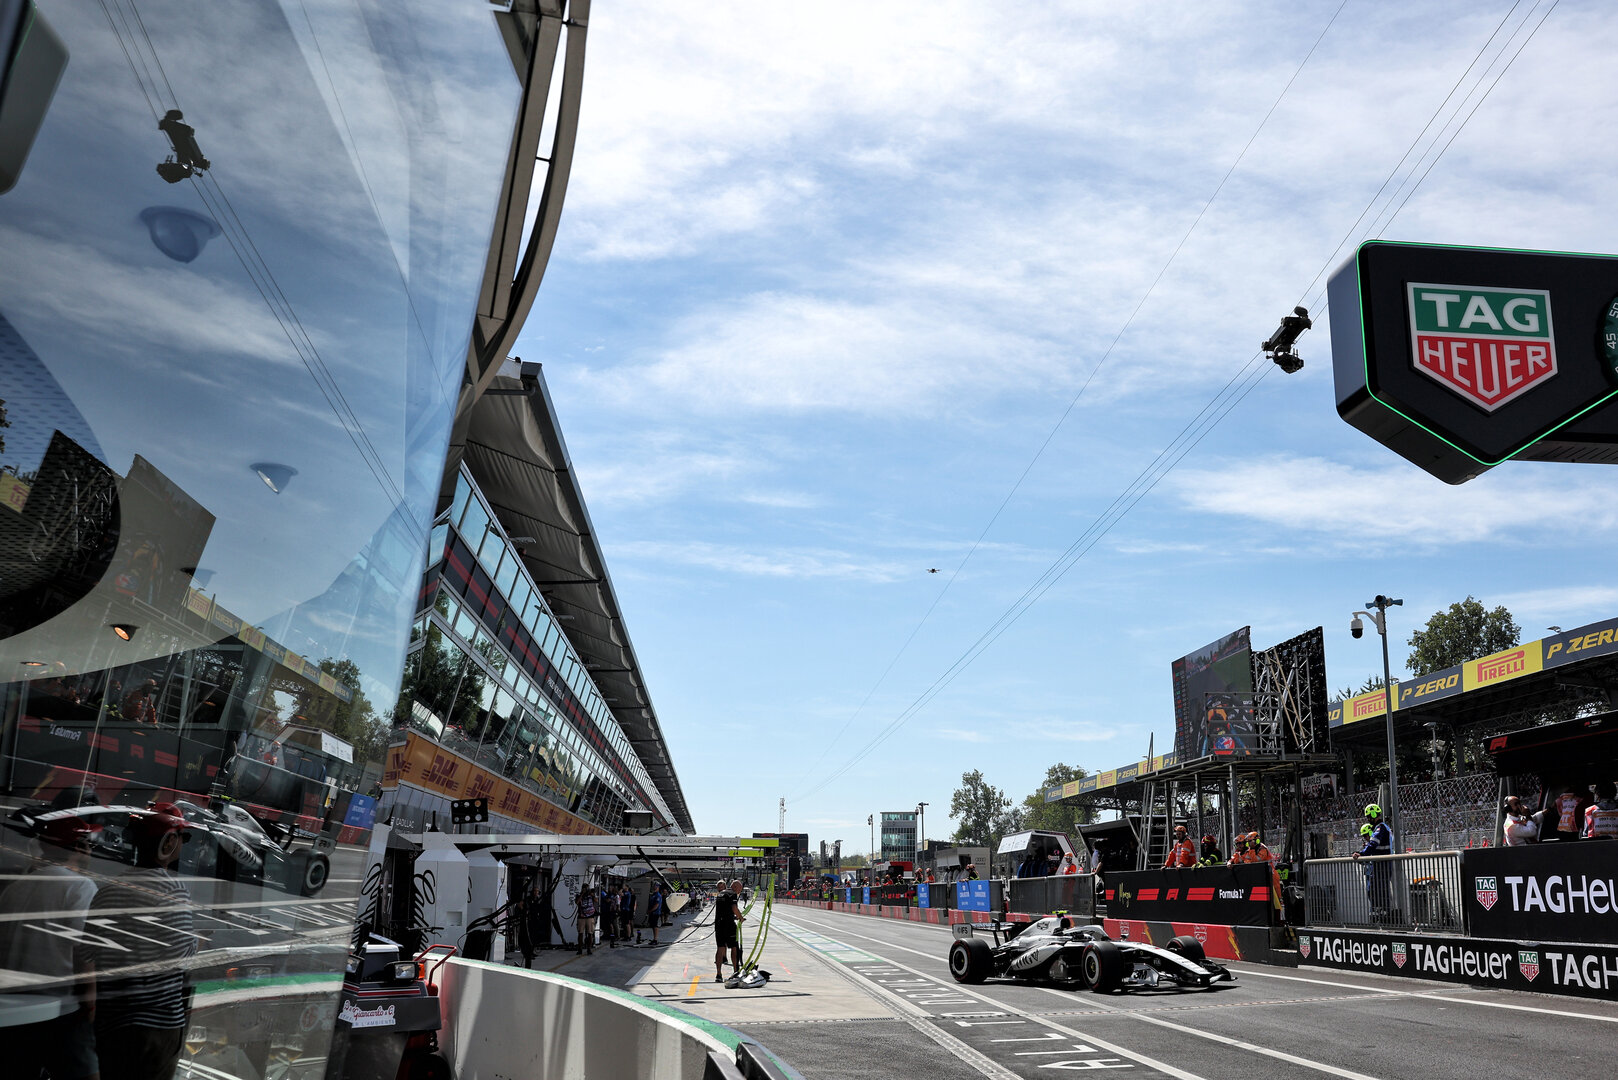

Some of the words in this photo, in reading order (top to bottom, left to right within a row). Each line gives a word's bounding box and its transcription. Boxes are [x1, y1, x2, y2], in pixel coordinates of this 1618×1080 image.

[1421, 292, 1540, 332] TAG
[1606, 333, 1617, 349] 45
[1423, 340, 1547, 400] HEUER
[1547, 642, 1562, 659] P
[1566, 627, 1618, 653] ZER
[1477, 650, 1525, 683] PIRELLI
[1401, 688, 1412, 701] P
[1414, 673, 1459, 698] ZERO
[1353, 692, 1386, 717] PIRELLI
[1122, 768, 1137, 778] ZERO
[1477, 878, 1496, 890] TAG
[1218, 889, 1239, 899] Formula
[1477, 891, 1498, 909] HEUER
[1313, 936, 1387, 966] TAGHeuer
[1393, 943, 1406, 953] TAG
[1411, 944, 1512, 980] TAGHeuer
[1519, 952, 1538, 964] TAG
[1133, 969, 1147, 979] 3M
[1519, 964, 1539, 982] HEUER
